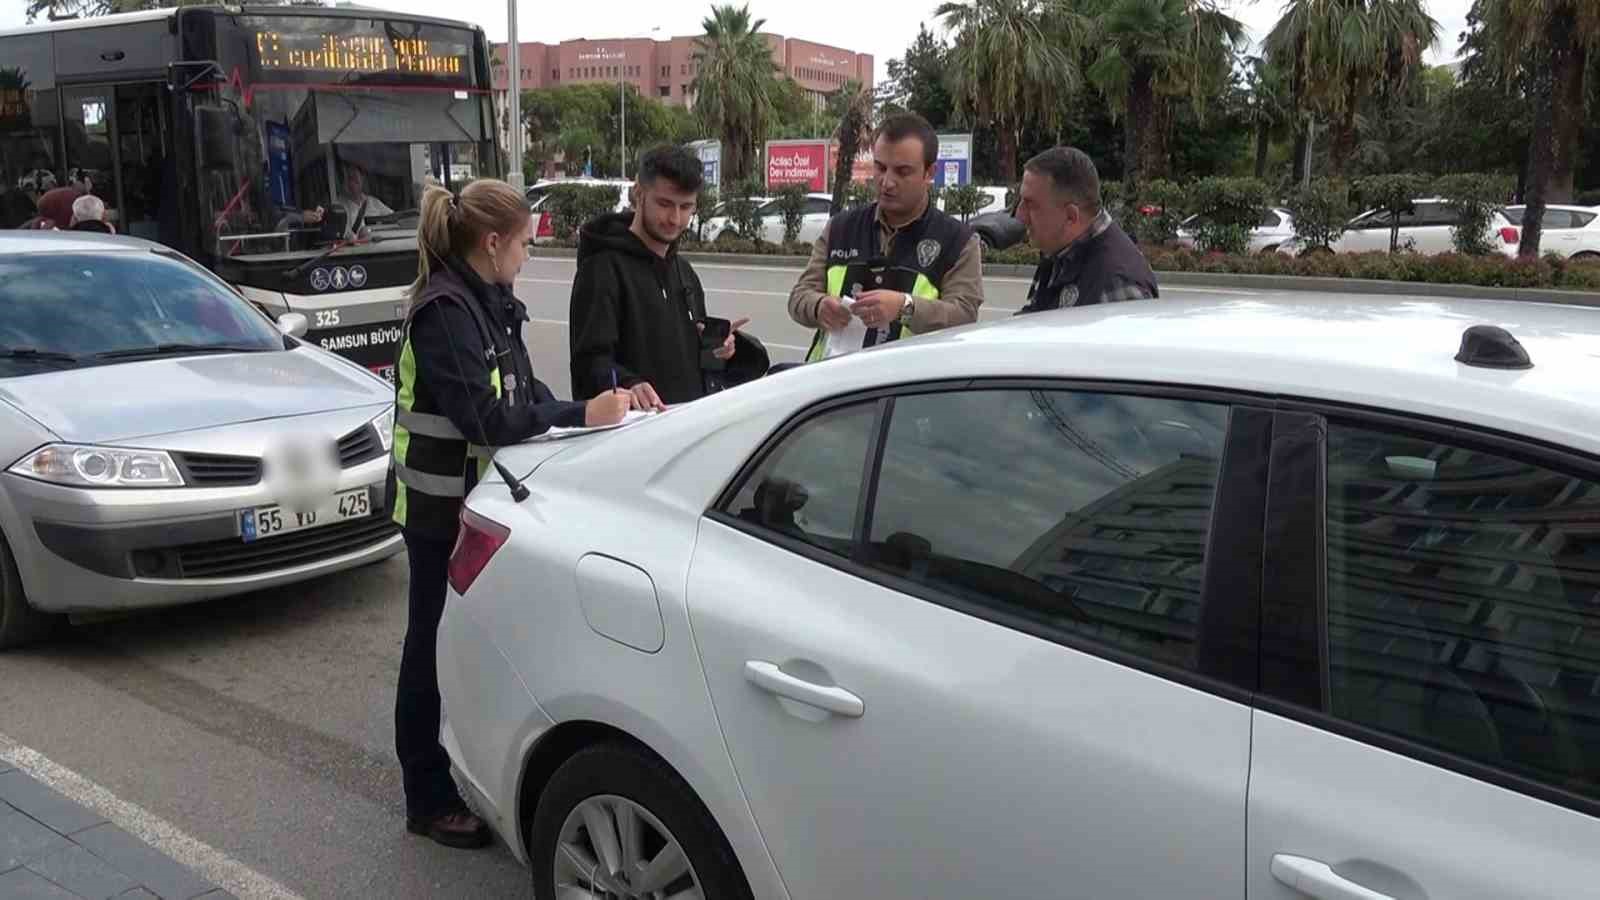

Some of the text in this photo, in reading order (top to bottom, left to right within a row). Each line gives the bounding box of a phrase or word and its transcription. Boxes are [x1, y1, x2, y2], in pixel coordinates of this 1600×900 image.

[315, 310, 340, 327] 325
[321, 333, 368, 351] SAMSUN
[258, 509, 282, 534] 55
[337, 492, 368, 518] 425
